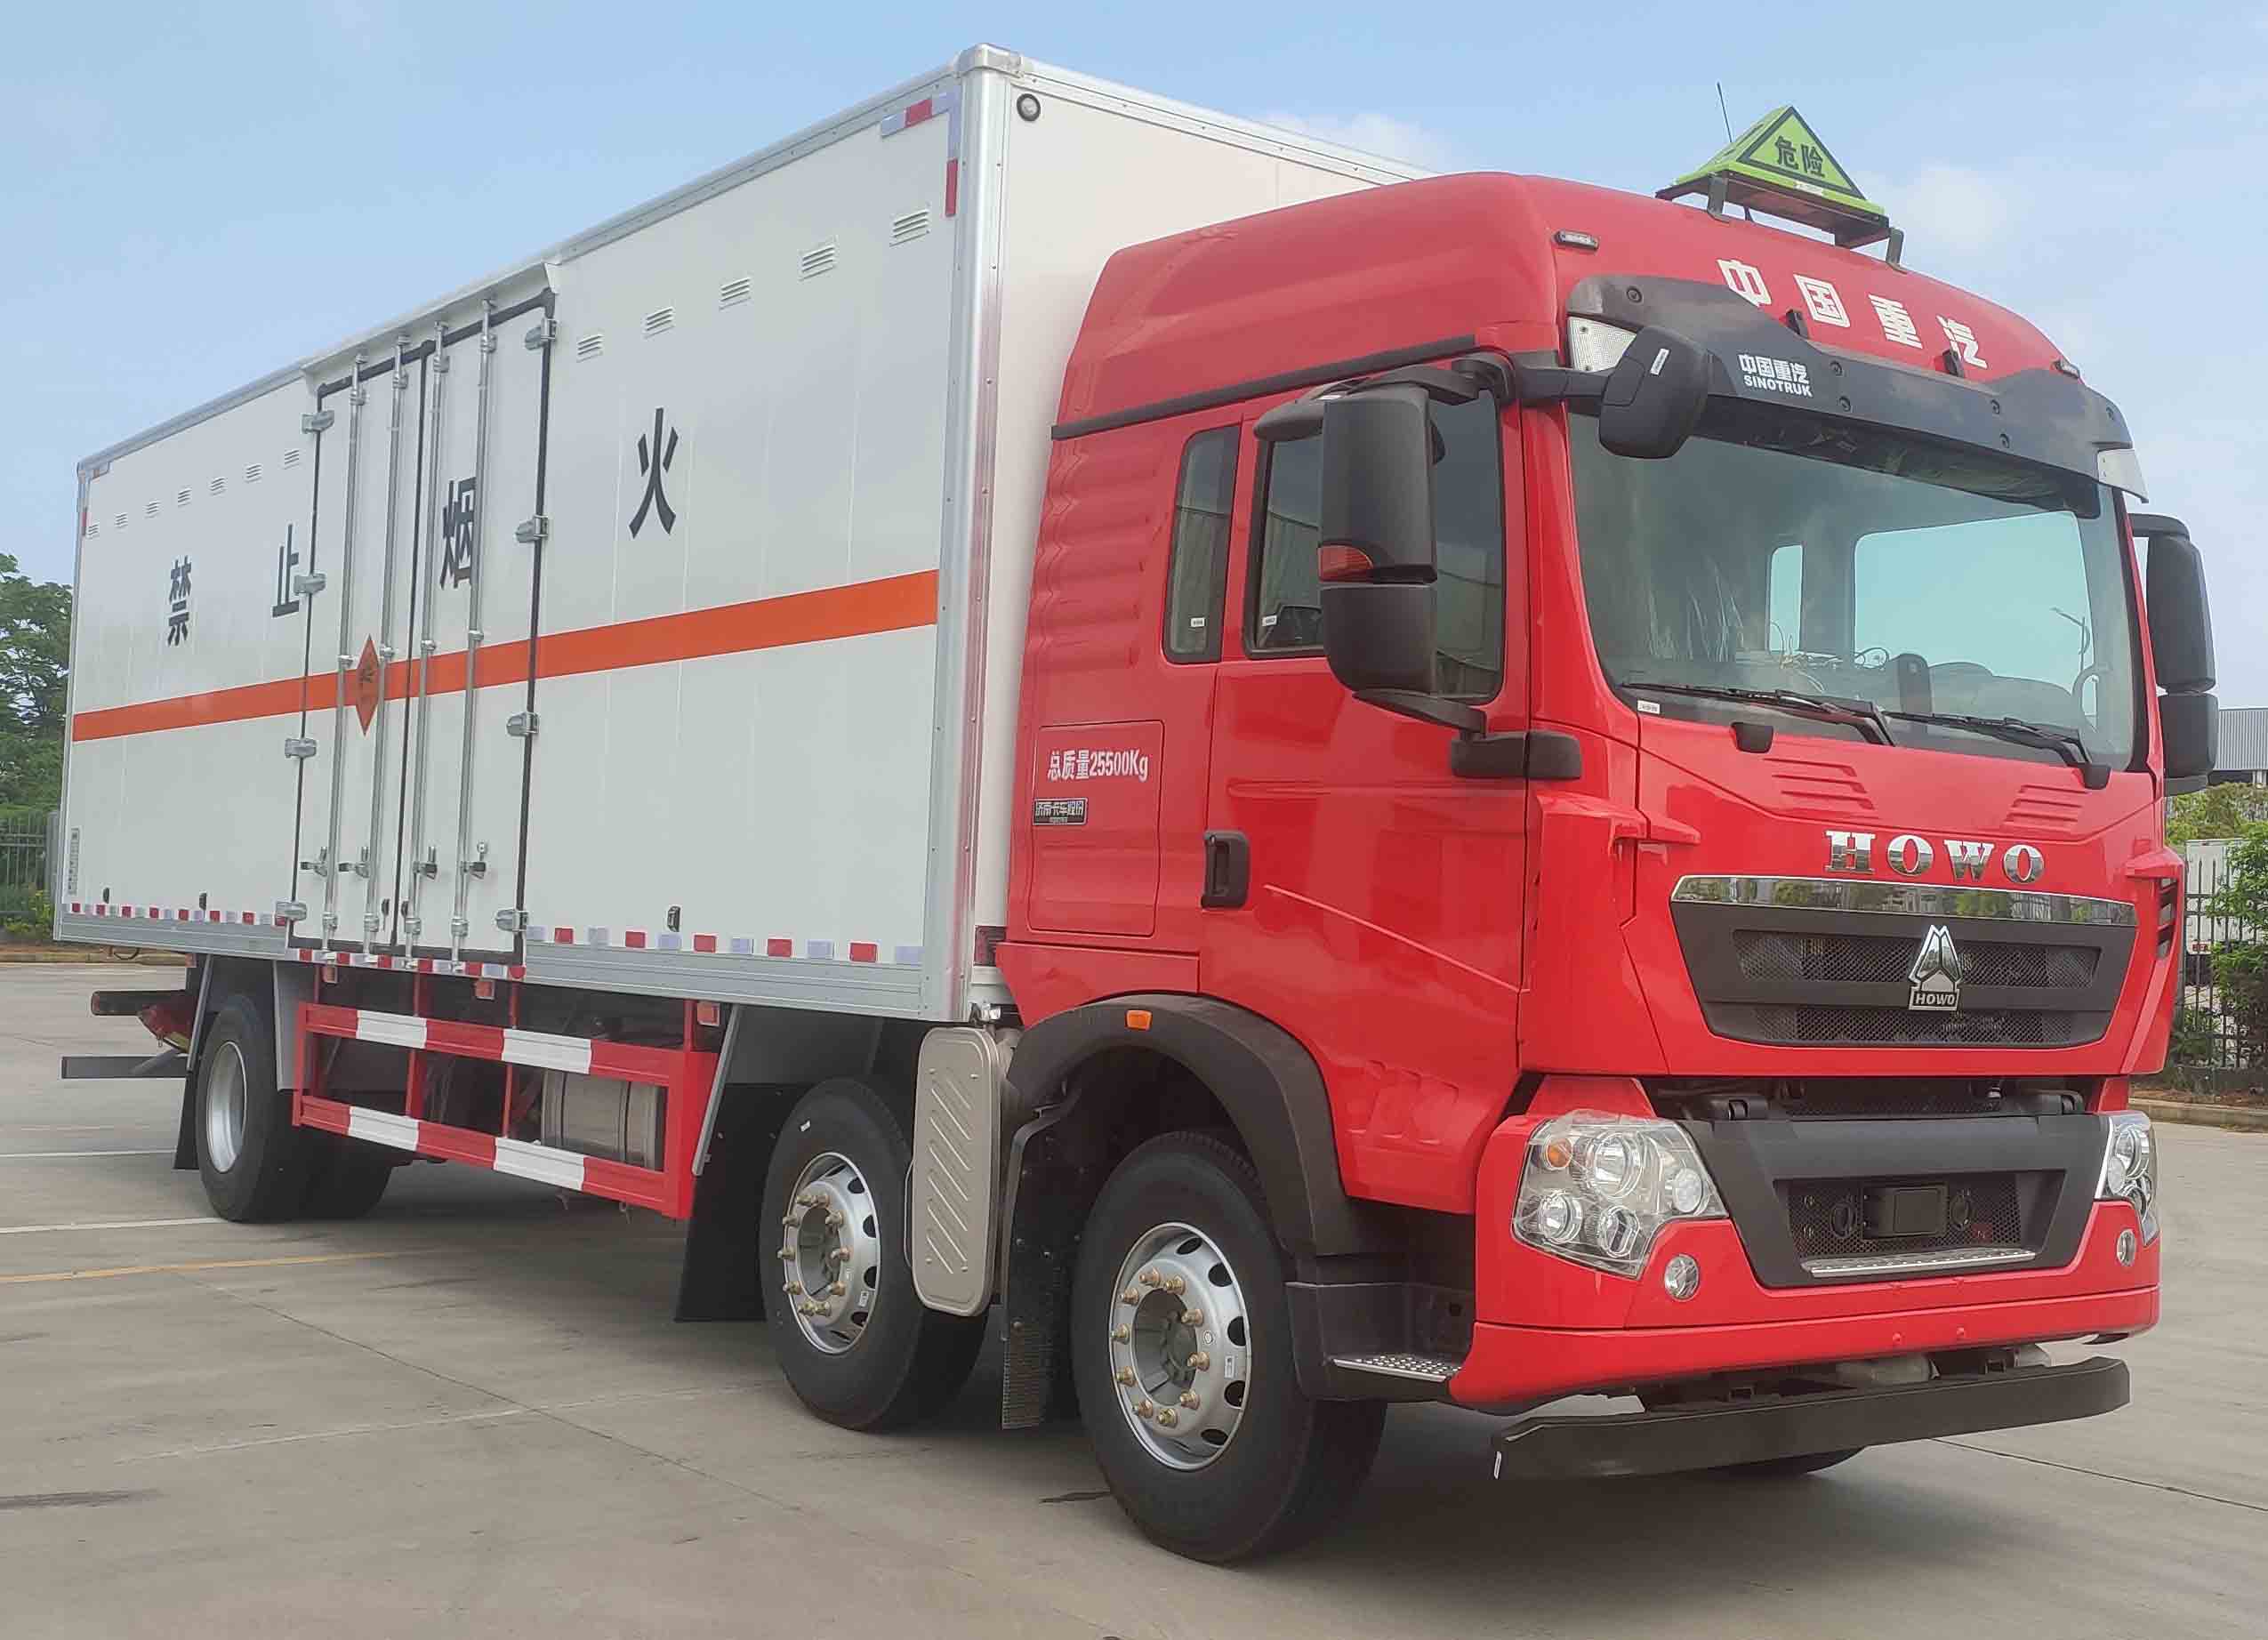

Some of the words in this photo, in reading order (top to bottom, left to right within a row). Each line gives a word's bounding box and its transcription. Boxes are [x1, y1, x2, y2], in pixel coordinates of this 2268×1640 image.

[1774, 135, 1825, 178] 危险
[1717, 259, 1988, 369] 中国重汽
[1738, 354, 1810, 385] 中国重汽
[1743, 374, 1814, 398] SINOTRUK
[1047, 749, 1149, 783] 总质量25500Kg
[1825, 831, 2045, 884] HOWO
[1915, 993, 1955, 1005] HOWO
